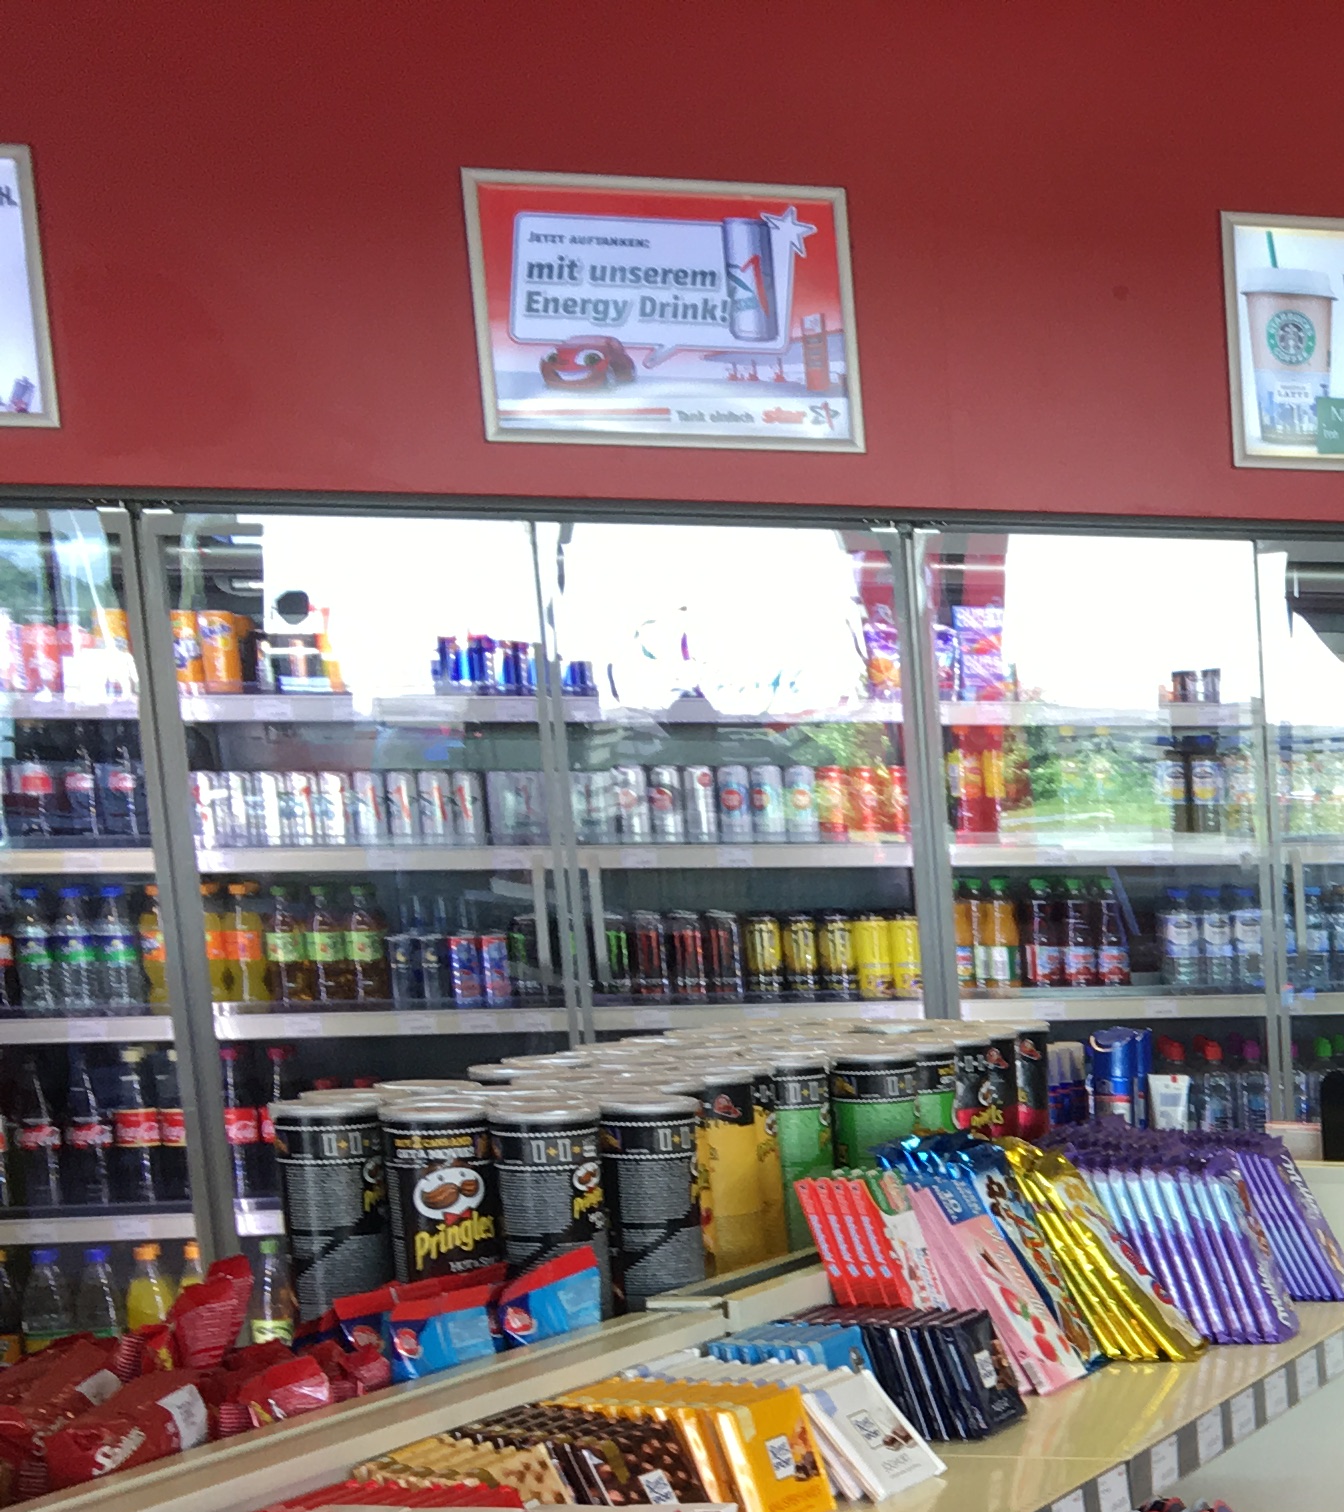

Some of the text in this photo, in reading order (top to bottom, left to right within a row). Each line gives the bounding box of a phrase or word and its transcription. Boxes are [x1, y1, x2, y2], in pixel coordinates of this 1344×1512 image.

[526, 255, 718, 287] mit unserem
[525, 290, 730, 323] Energy Drink!
[415, 1210, 495, 1271] Pringles
